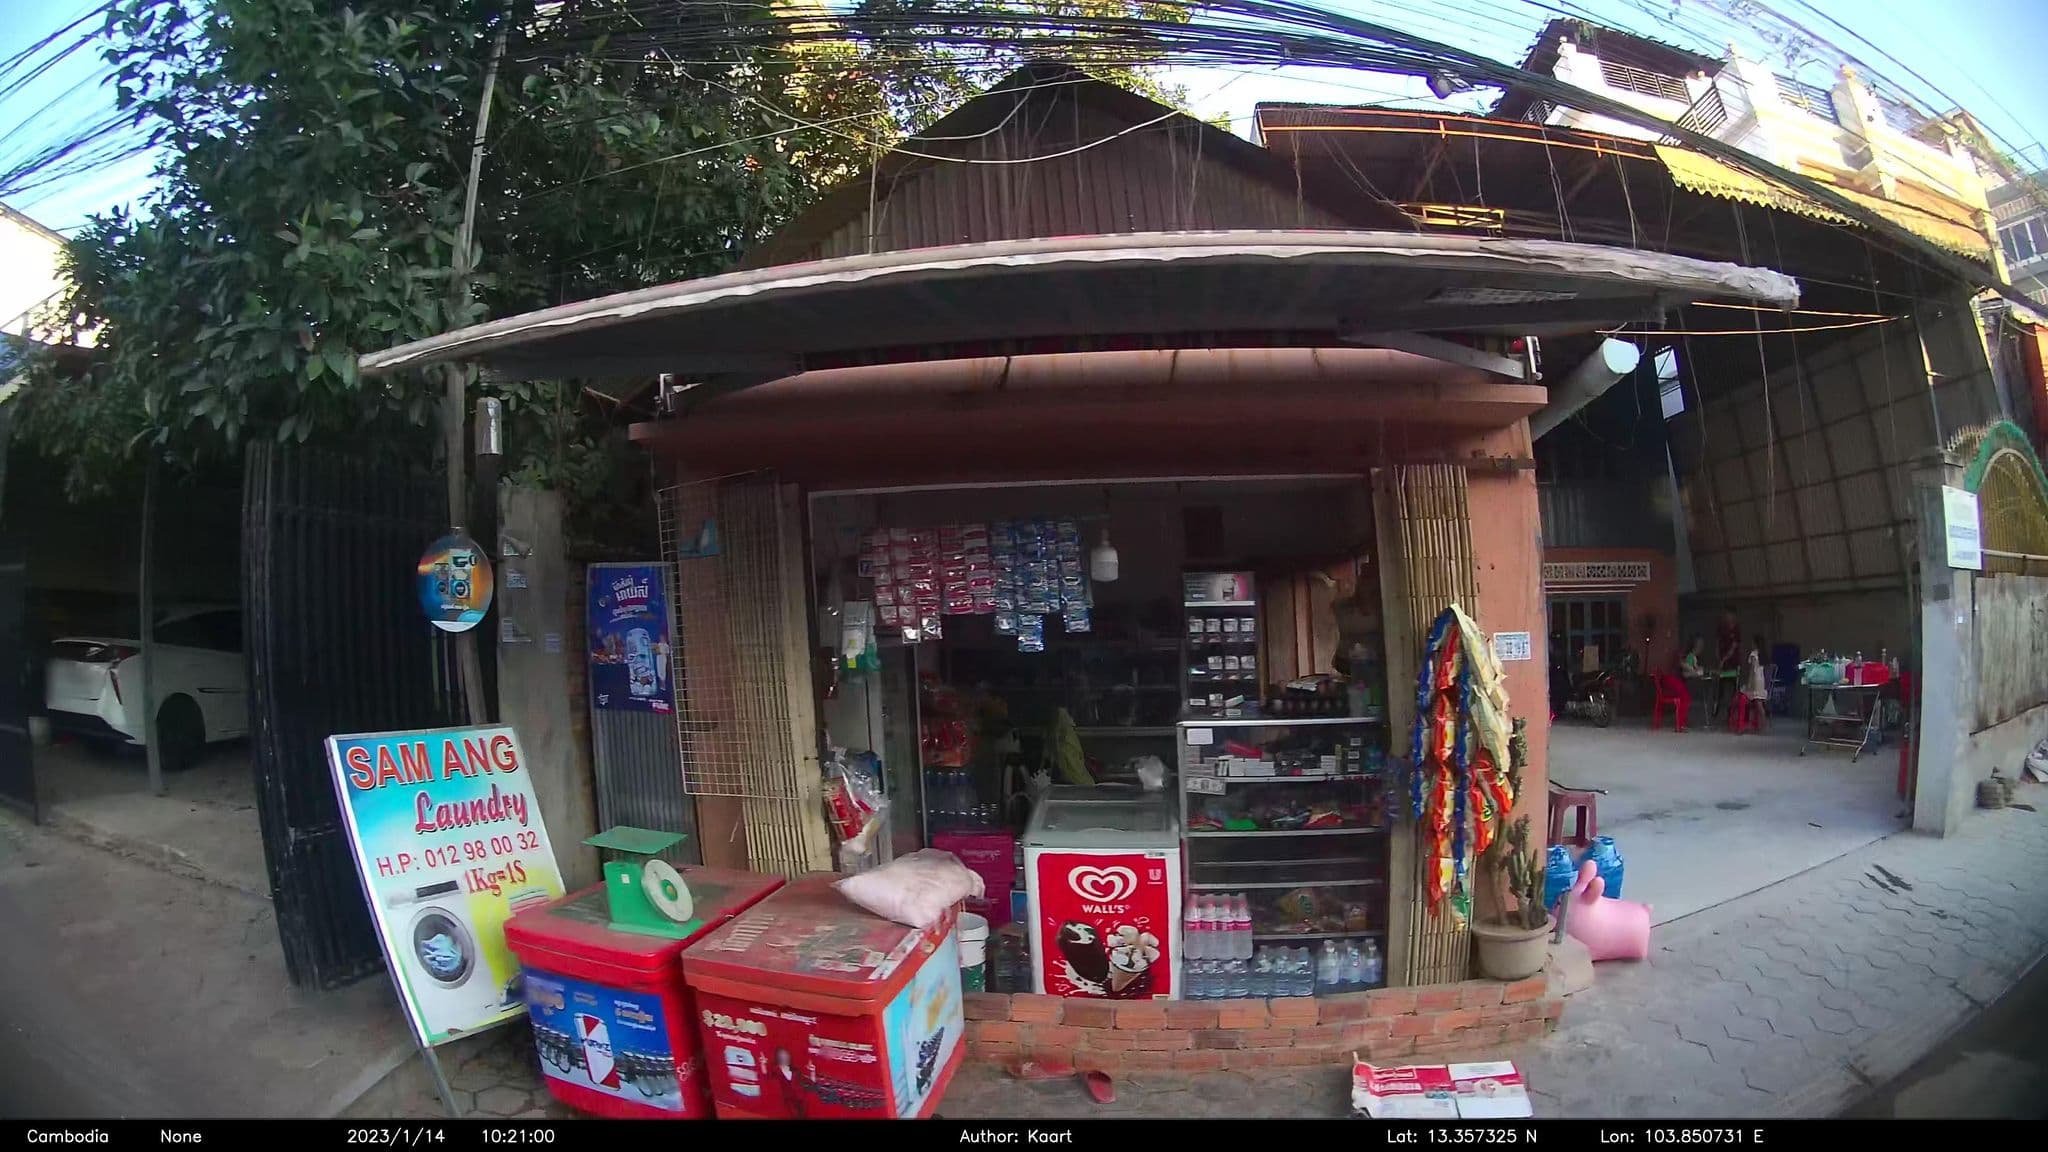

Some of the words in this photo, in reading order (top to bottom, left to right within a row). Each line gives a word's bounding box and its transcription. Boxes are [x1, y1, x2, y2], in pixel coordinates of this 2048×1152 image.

[346, 741, 434, 790] SAM
[443, 734, 519, 779] ANG
[415, 783, 528, 834] Laundry
[376, 852, 421, 877] H.P:
[424, 844, 461, 868] 012
[464, 839, 487, 861] 98
[491, 834, 513, 856] 00
[516, 830, 540, 850] 32
[1081, 903, 1126, 915] WALL'S
